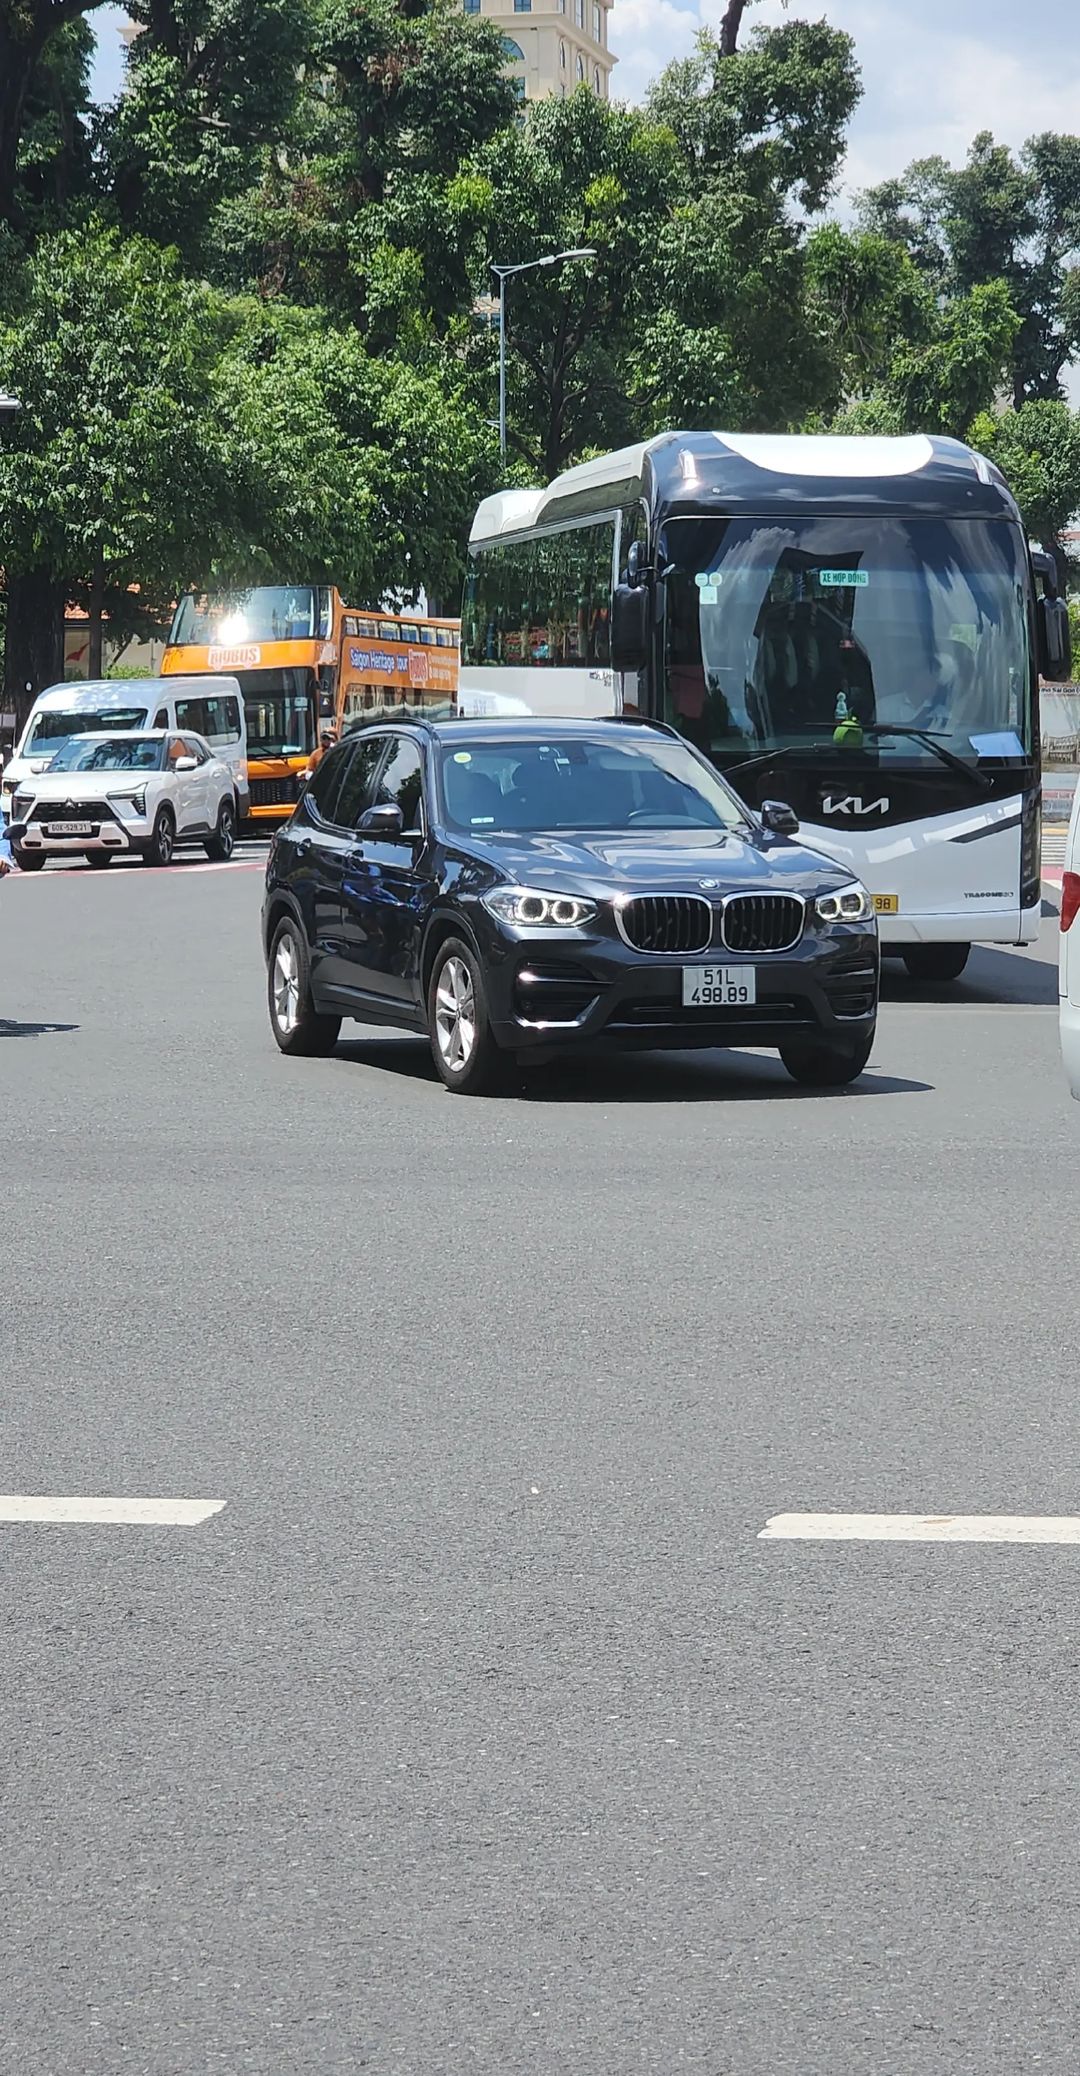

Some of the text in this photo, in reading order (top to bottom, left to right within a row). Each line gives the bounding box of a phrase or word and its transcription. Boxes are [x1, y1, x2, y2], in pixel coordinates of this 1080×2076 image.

[822, 572, 832, 584] XE
[349, 648, 369, 671] Saigon
[370, 650, 395, 674] Heritage
[823, 796, 889, 814] KIA
[704, 969, 735, 985] 51L
[691, 986, 748, 1003] 498.89
